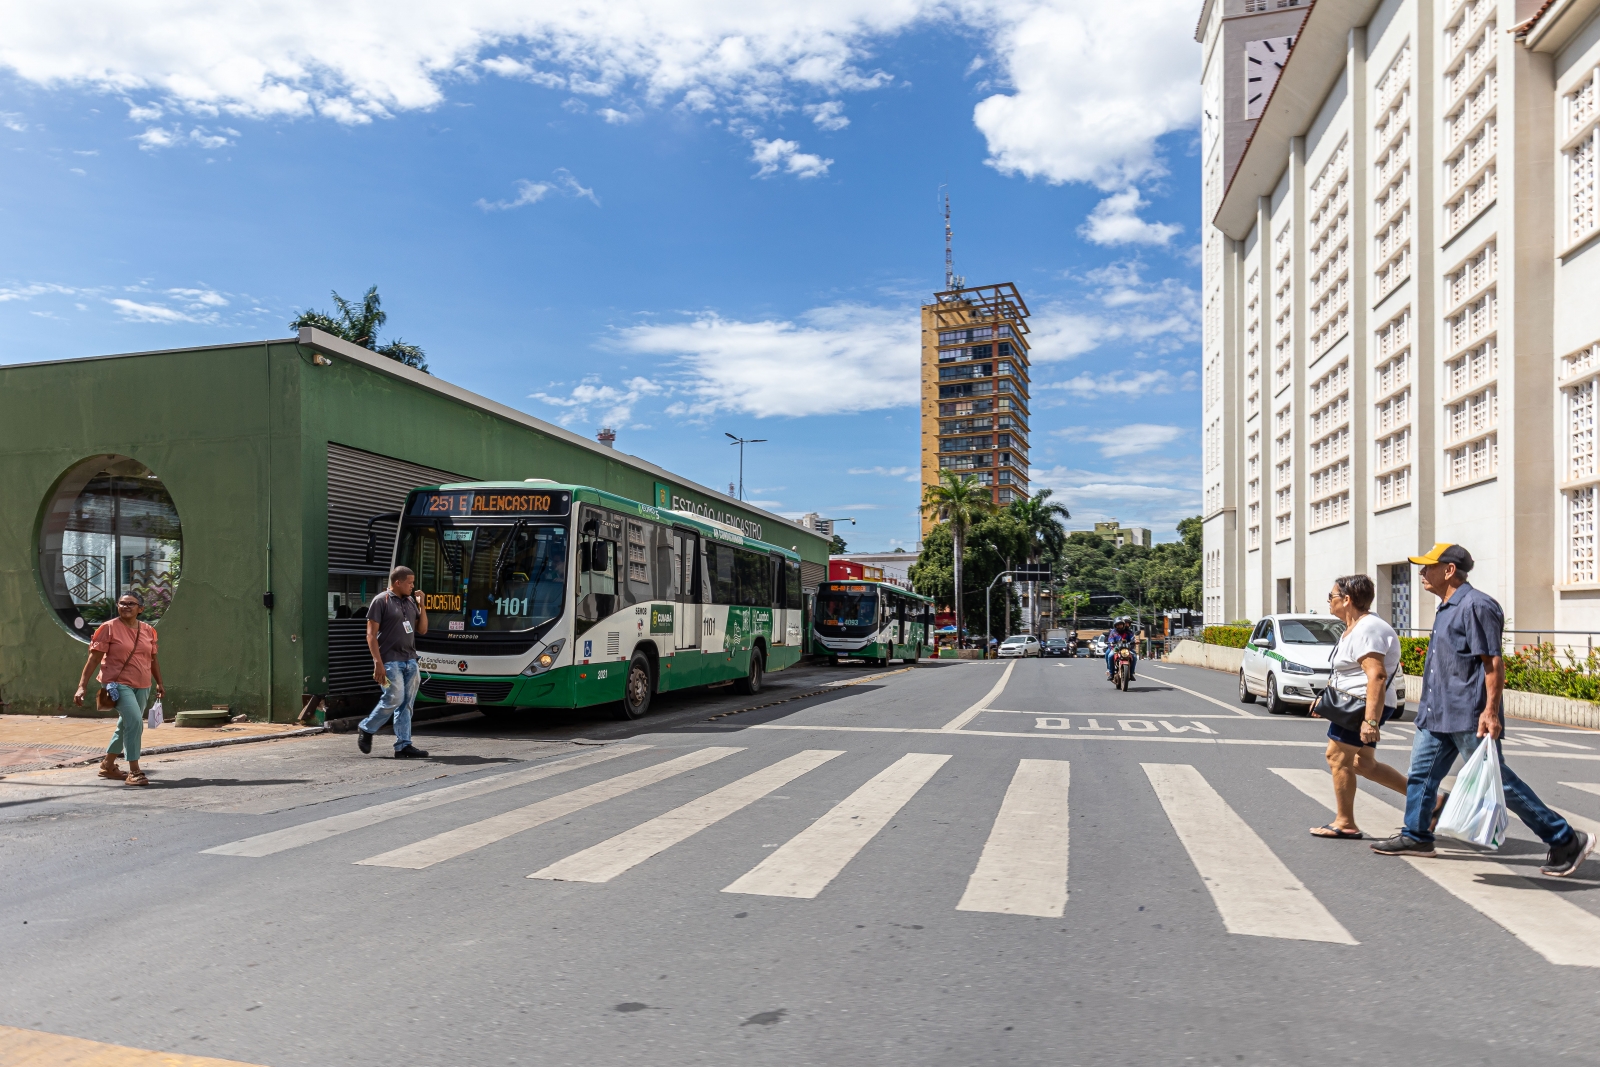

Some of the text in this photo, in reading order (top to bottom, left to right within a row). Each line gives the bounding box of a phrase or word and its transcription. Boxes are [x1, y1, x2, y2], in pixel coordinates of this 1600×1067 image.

[429, 495, 454, 511] 251
[717, 510, 762, 540] ALENCASTRO
[494, 597, 528, 616] 1101
[657, 612, 673, 622] CUIABÁ
[703, 617, 716, 637] 1101
[597, 669, 608, 680] 2021
[1034, 717, 1219, 735] MOTO
